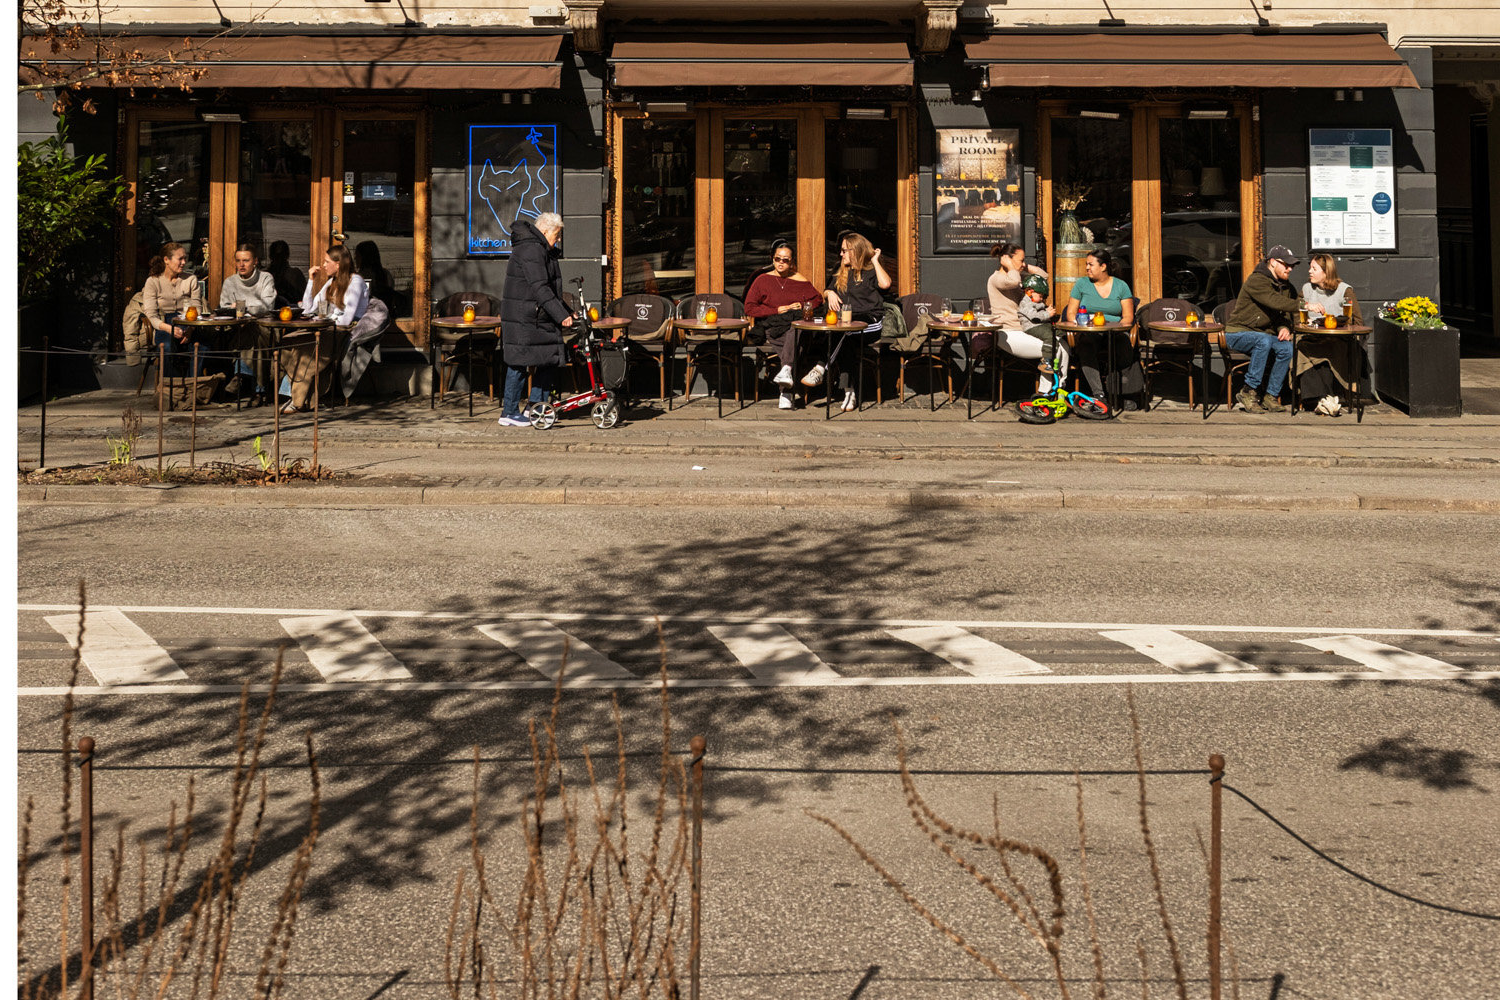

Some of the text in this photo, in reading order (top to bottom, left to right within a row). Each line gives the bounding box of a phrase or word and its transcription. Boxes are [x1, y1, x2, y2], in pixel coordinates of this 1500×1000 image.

[951, 136, 1006, 144] PRIVATE
[959, 147, 997, 155] ROOM
[471, 236, 507, 248] kitchen
